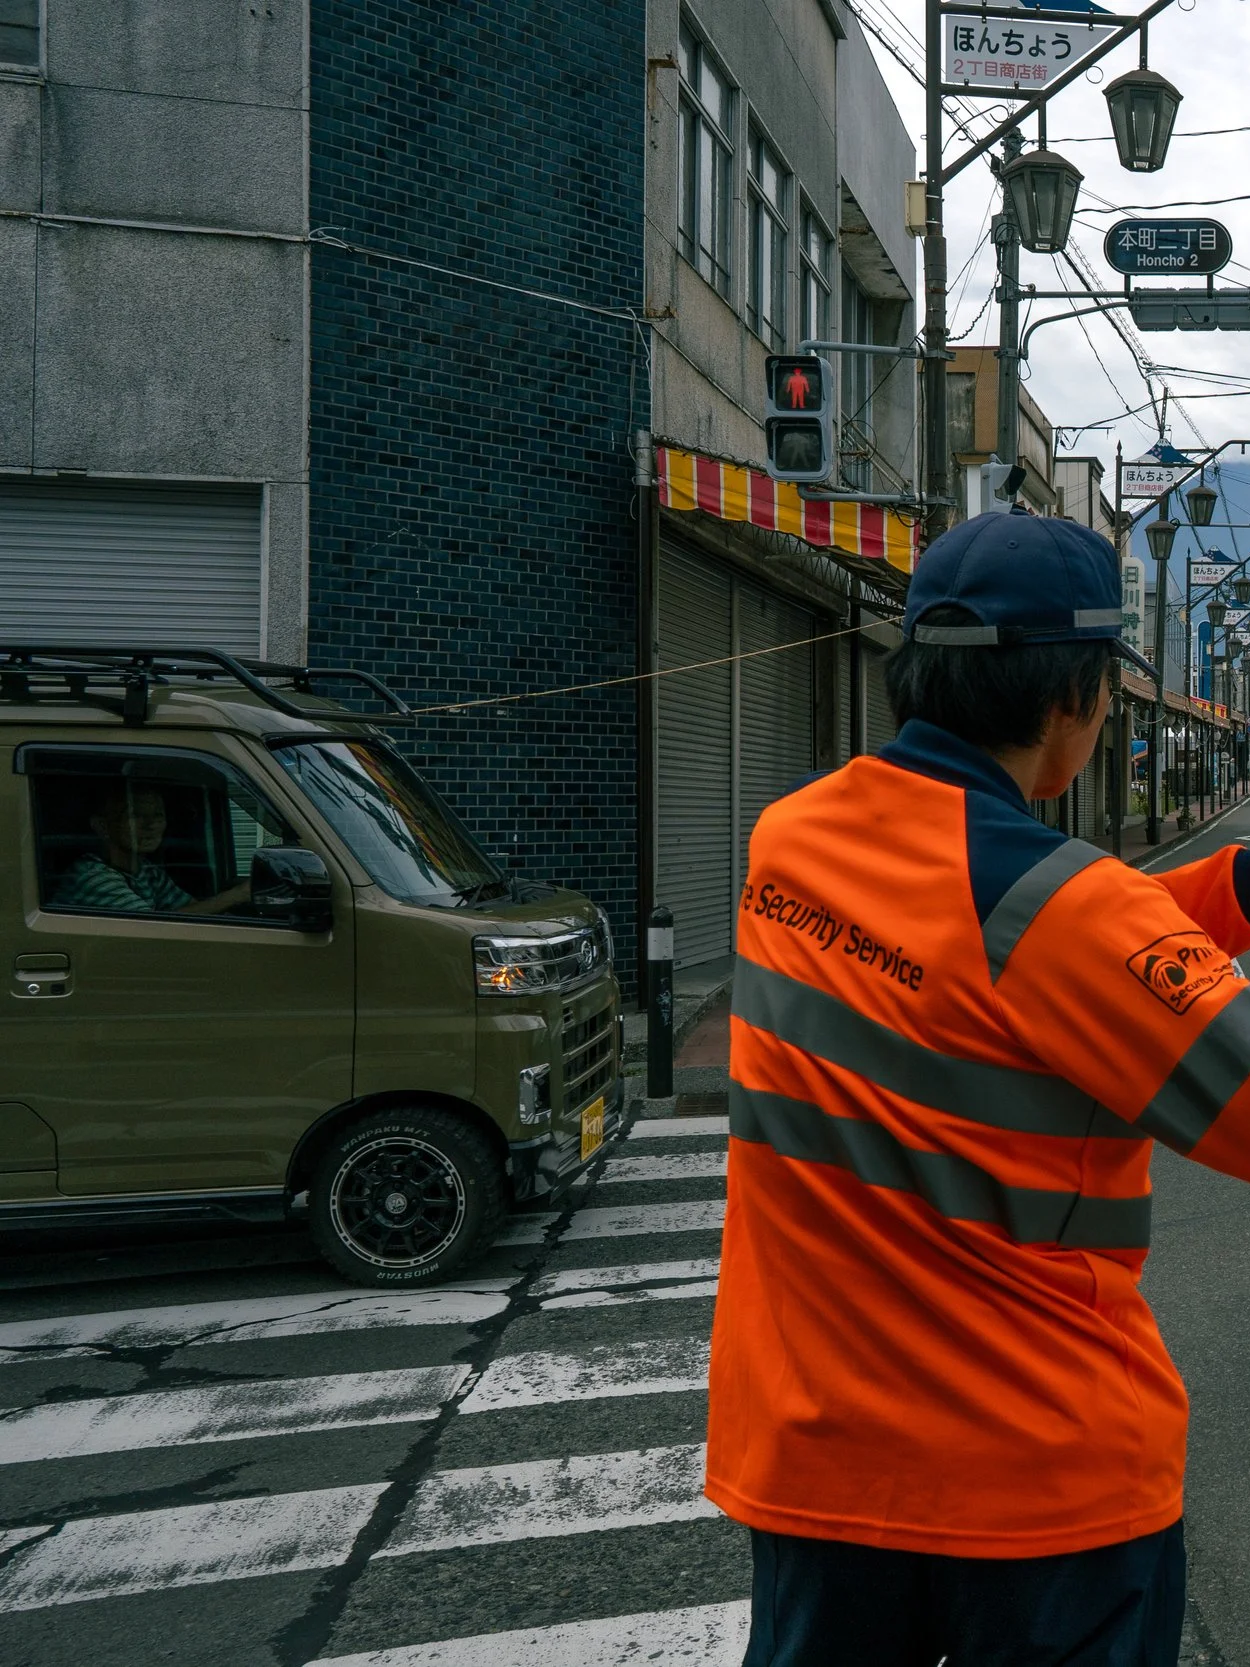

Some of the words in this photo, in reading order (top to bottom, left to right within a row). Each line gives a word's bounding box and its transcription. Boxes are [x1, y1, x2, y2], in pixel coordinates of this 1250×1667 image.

[953, 25, 1072, 60] ほんちょう
[953, 59, 1048, 81] 2丁目商店街
[1118, 228, 1217, 251] 本町二丁目
[1137, 254, 1185, 267] Honcho
[1190, 254, 1199, 267] 2
[1126, 470, 1174, 483] ほんちょう
[1193, 567, 1226, 576] ほんちょう
[754, 883, 845, 952] Security
[843, 924, 924, 992] Service
[1169, 975, 1214, 1008] Security
[340, 1125, 400, 1153] WANPAKU
[404, 1125, 432, 1138] M/T
[376, 1262, 440, 1280] MUDSTAR
